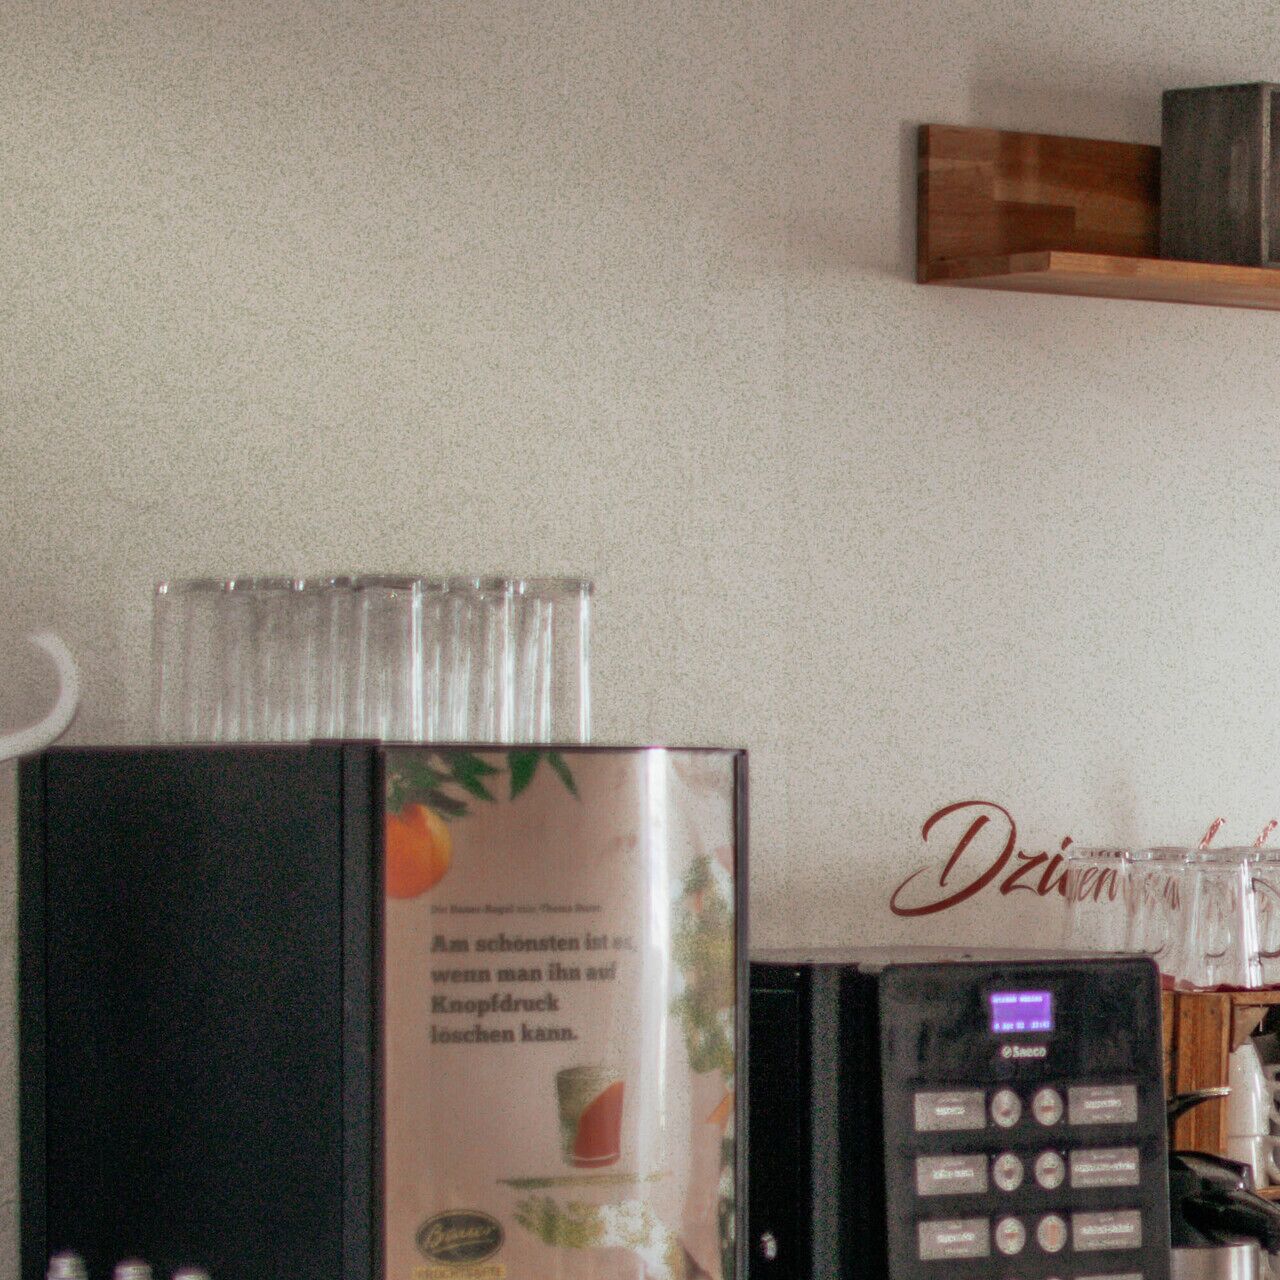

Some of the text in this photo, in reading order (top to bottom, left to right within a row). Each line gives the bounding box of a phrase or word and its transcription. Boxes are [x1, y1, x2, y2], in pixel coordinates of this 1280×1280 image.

[431, 934, 469, 952] Am
[584, 932, 608, 951] ist
[431, 961, 617, 983] wenn man ihn auf
[431, 992, 560, 1018] Knopfdruck
[521, 1022, 578, 1043] kann.
[1012, 1045, 1046, 1058] Saeco
